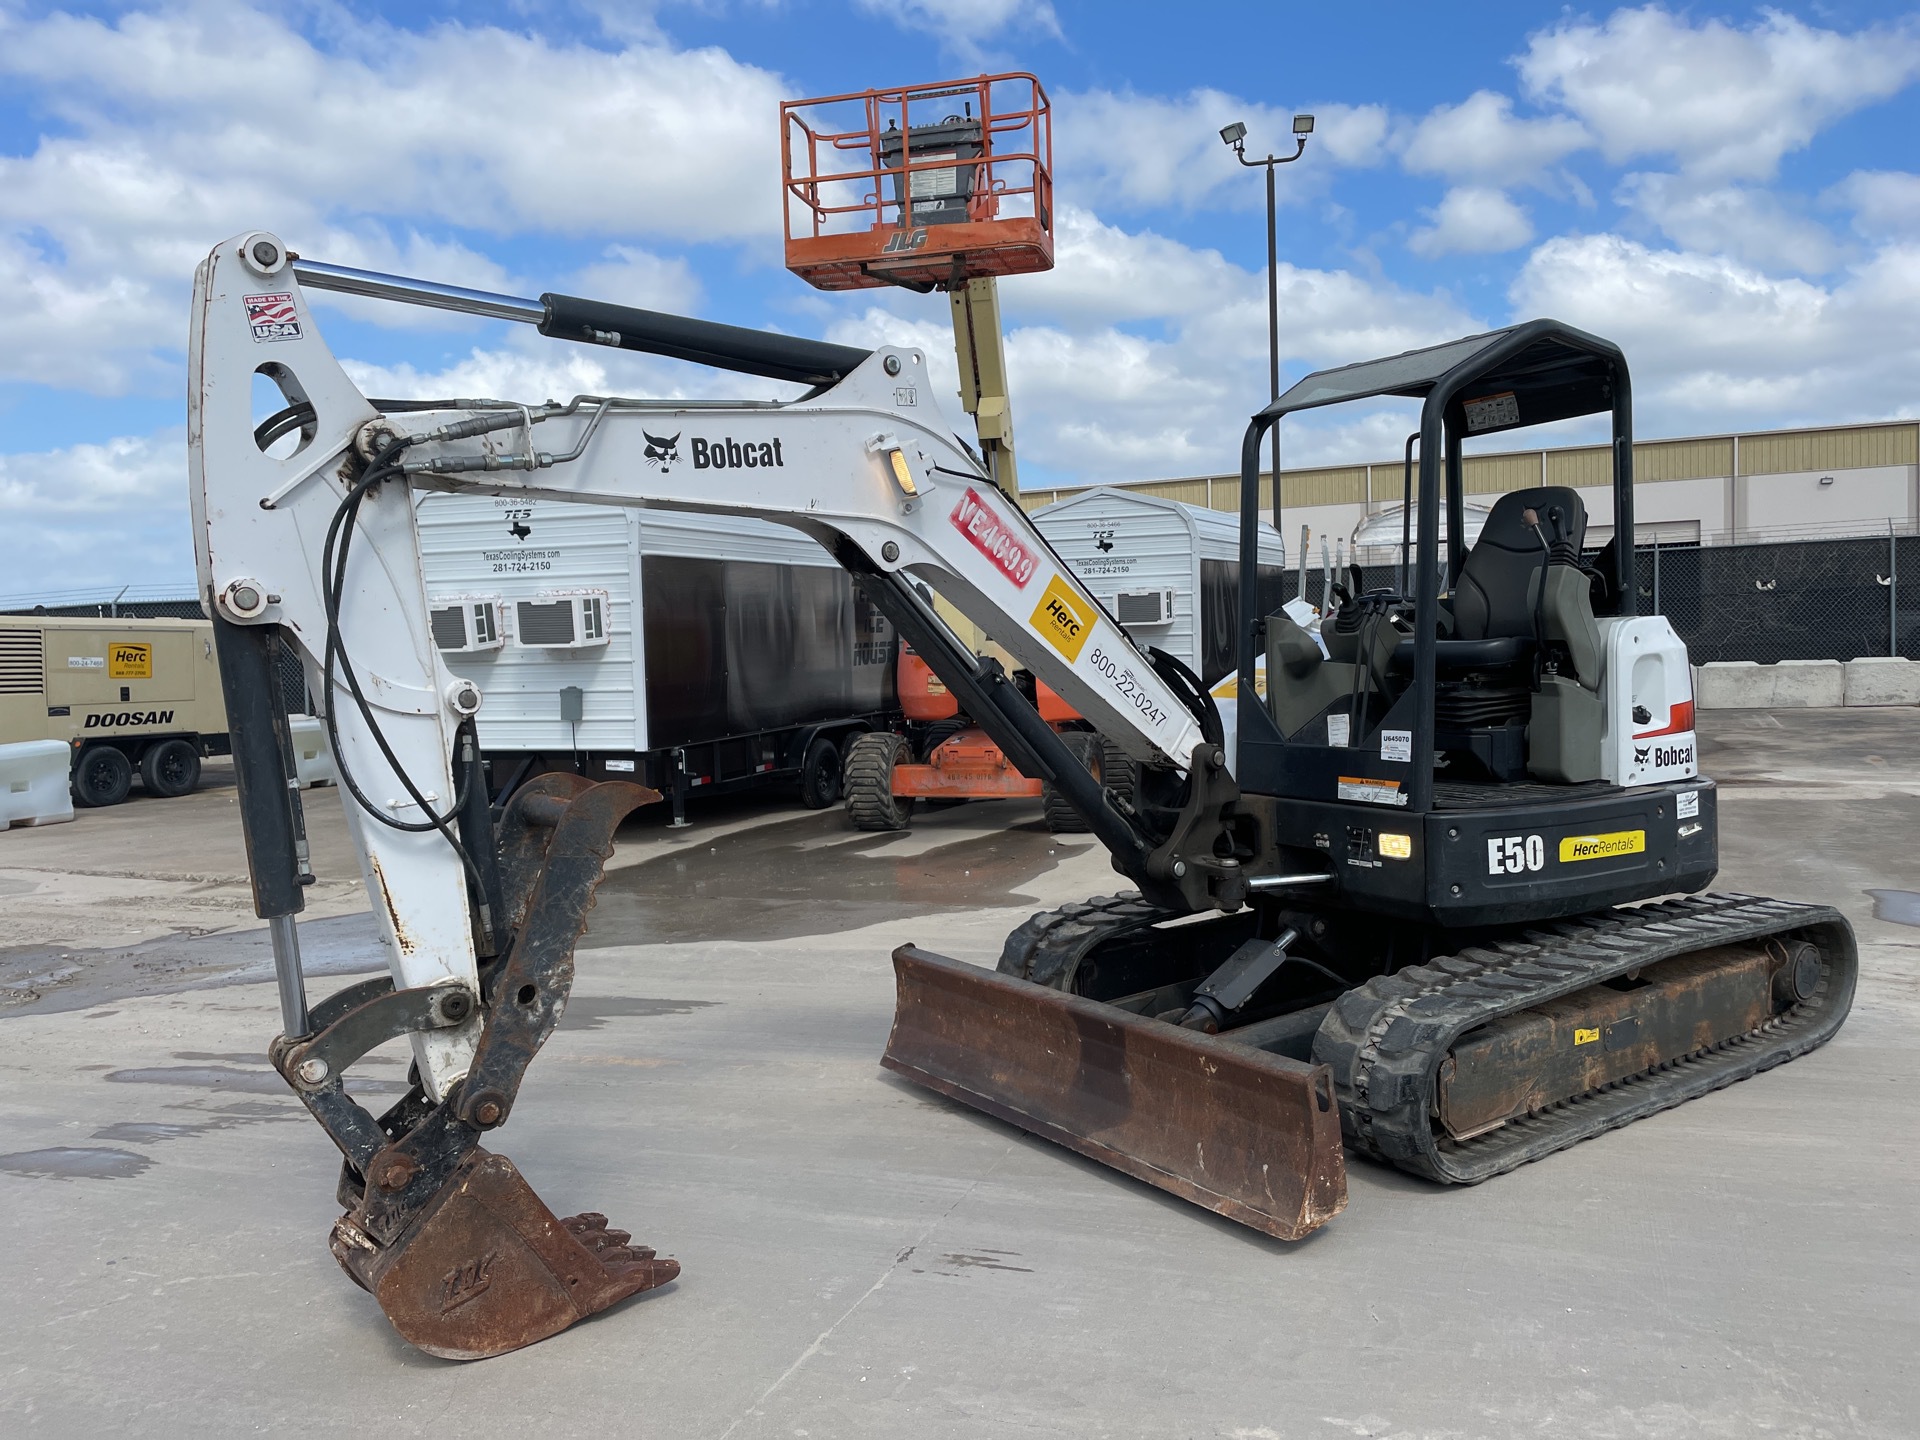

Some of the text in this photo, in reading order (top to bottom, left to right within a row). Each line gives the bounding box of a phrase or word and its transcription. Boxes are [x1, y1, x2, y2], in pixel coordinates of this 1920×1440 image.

[882, 229, 929, 254] JLG
[254, 324, 298, 338] USA
[690, 437, 784, 469] Bobcat
[492, 561, 551, 573] 281-724-2150
[1083, 565, 1130, 574] 281-724-2150
[1045, 599, 1080, 637] Herc
[1050, 620, 1073, 643] Rentals
[115, 650, 147, 662] Herc
[1090, 648, 1167, 727] 800-22-0247
[84, 710, 174, 729] DOOSAN
[1383, 735, 1410, 743] U645070
[1655, 744, 1694, 768] Bobcat
[1487, 834, 1545, 875] E50
[1573, 837, 1634, 857] HercRentals
